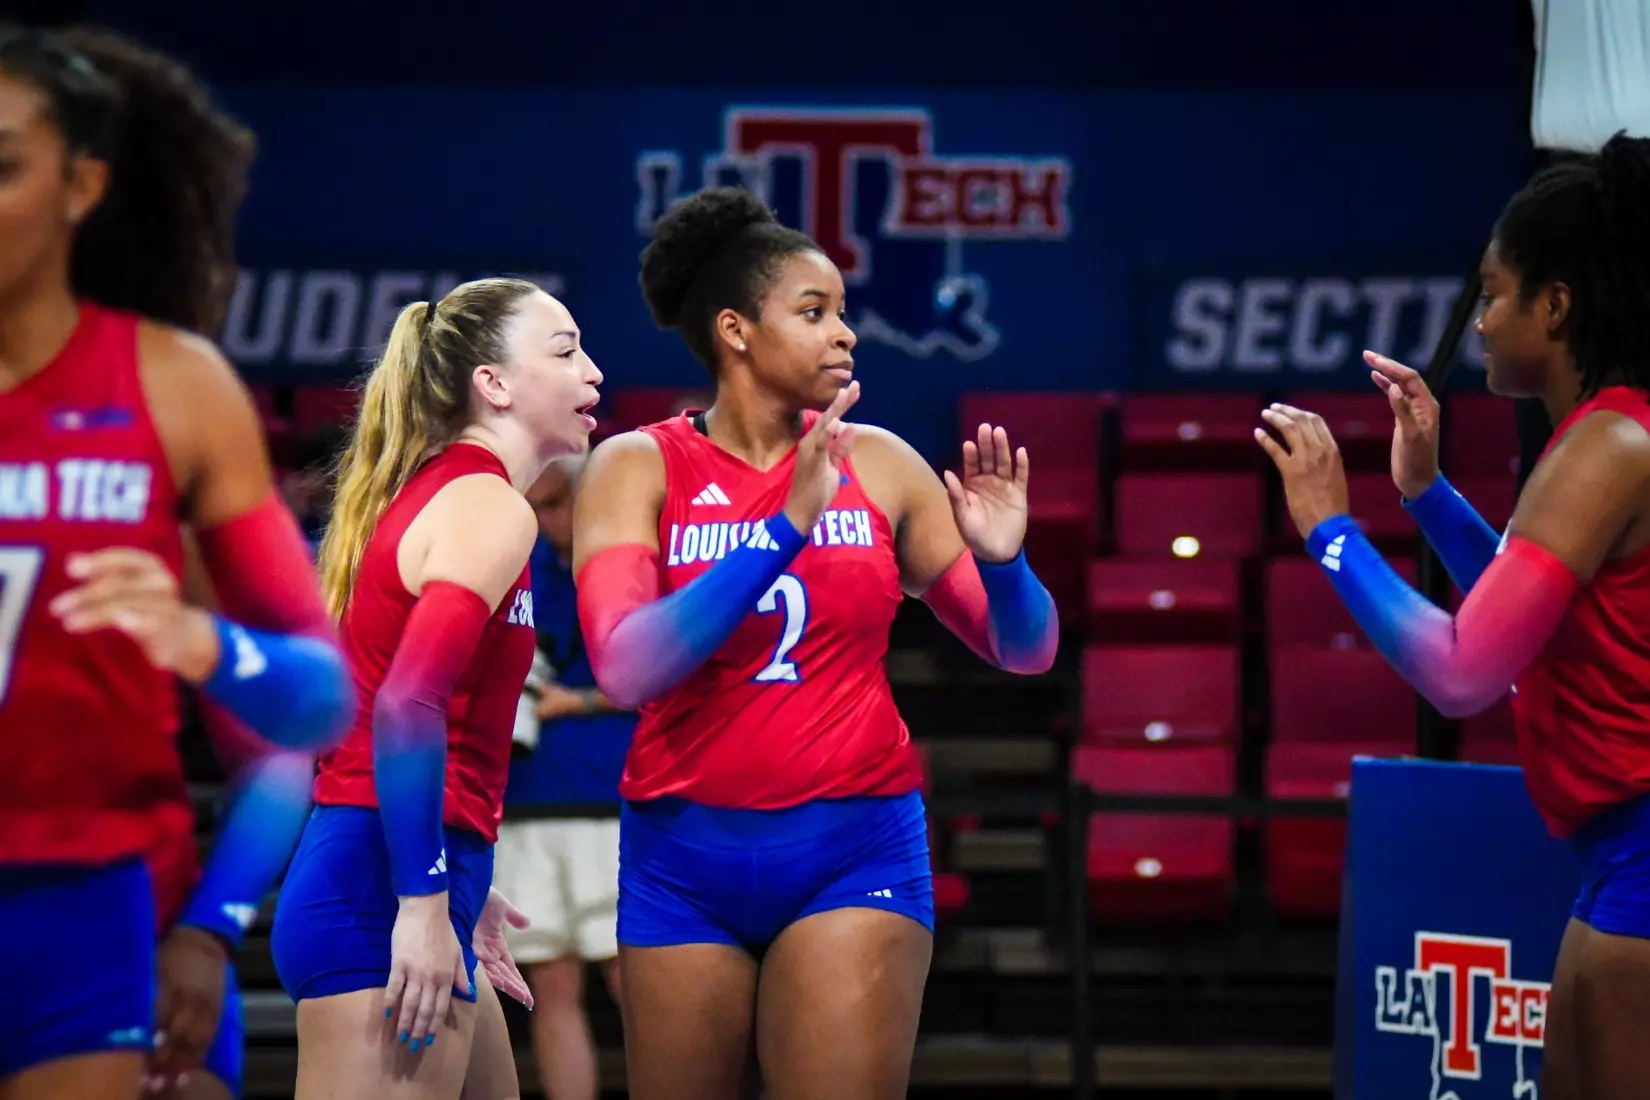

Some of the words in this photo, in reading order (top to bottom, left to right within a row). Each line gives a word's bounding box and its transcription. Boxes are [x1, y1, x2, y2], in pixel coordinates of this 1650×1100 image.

[725, 107, 1071, 284] TECH
[1165, 276, 1486, 372] SECTI
[56, 458, 153, 524] TECH
[755, 573, 808, 683] 2
[1375, 965, 1437, 1036] LA
[1414, 930, 1552, 1080] TEC
